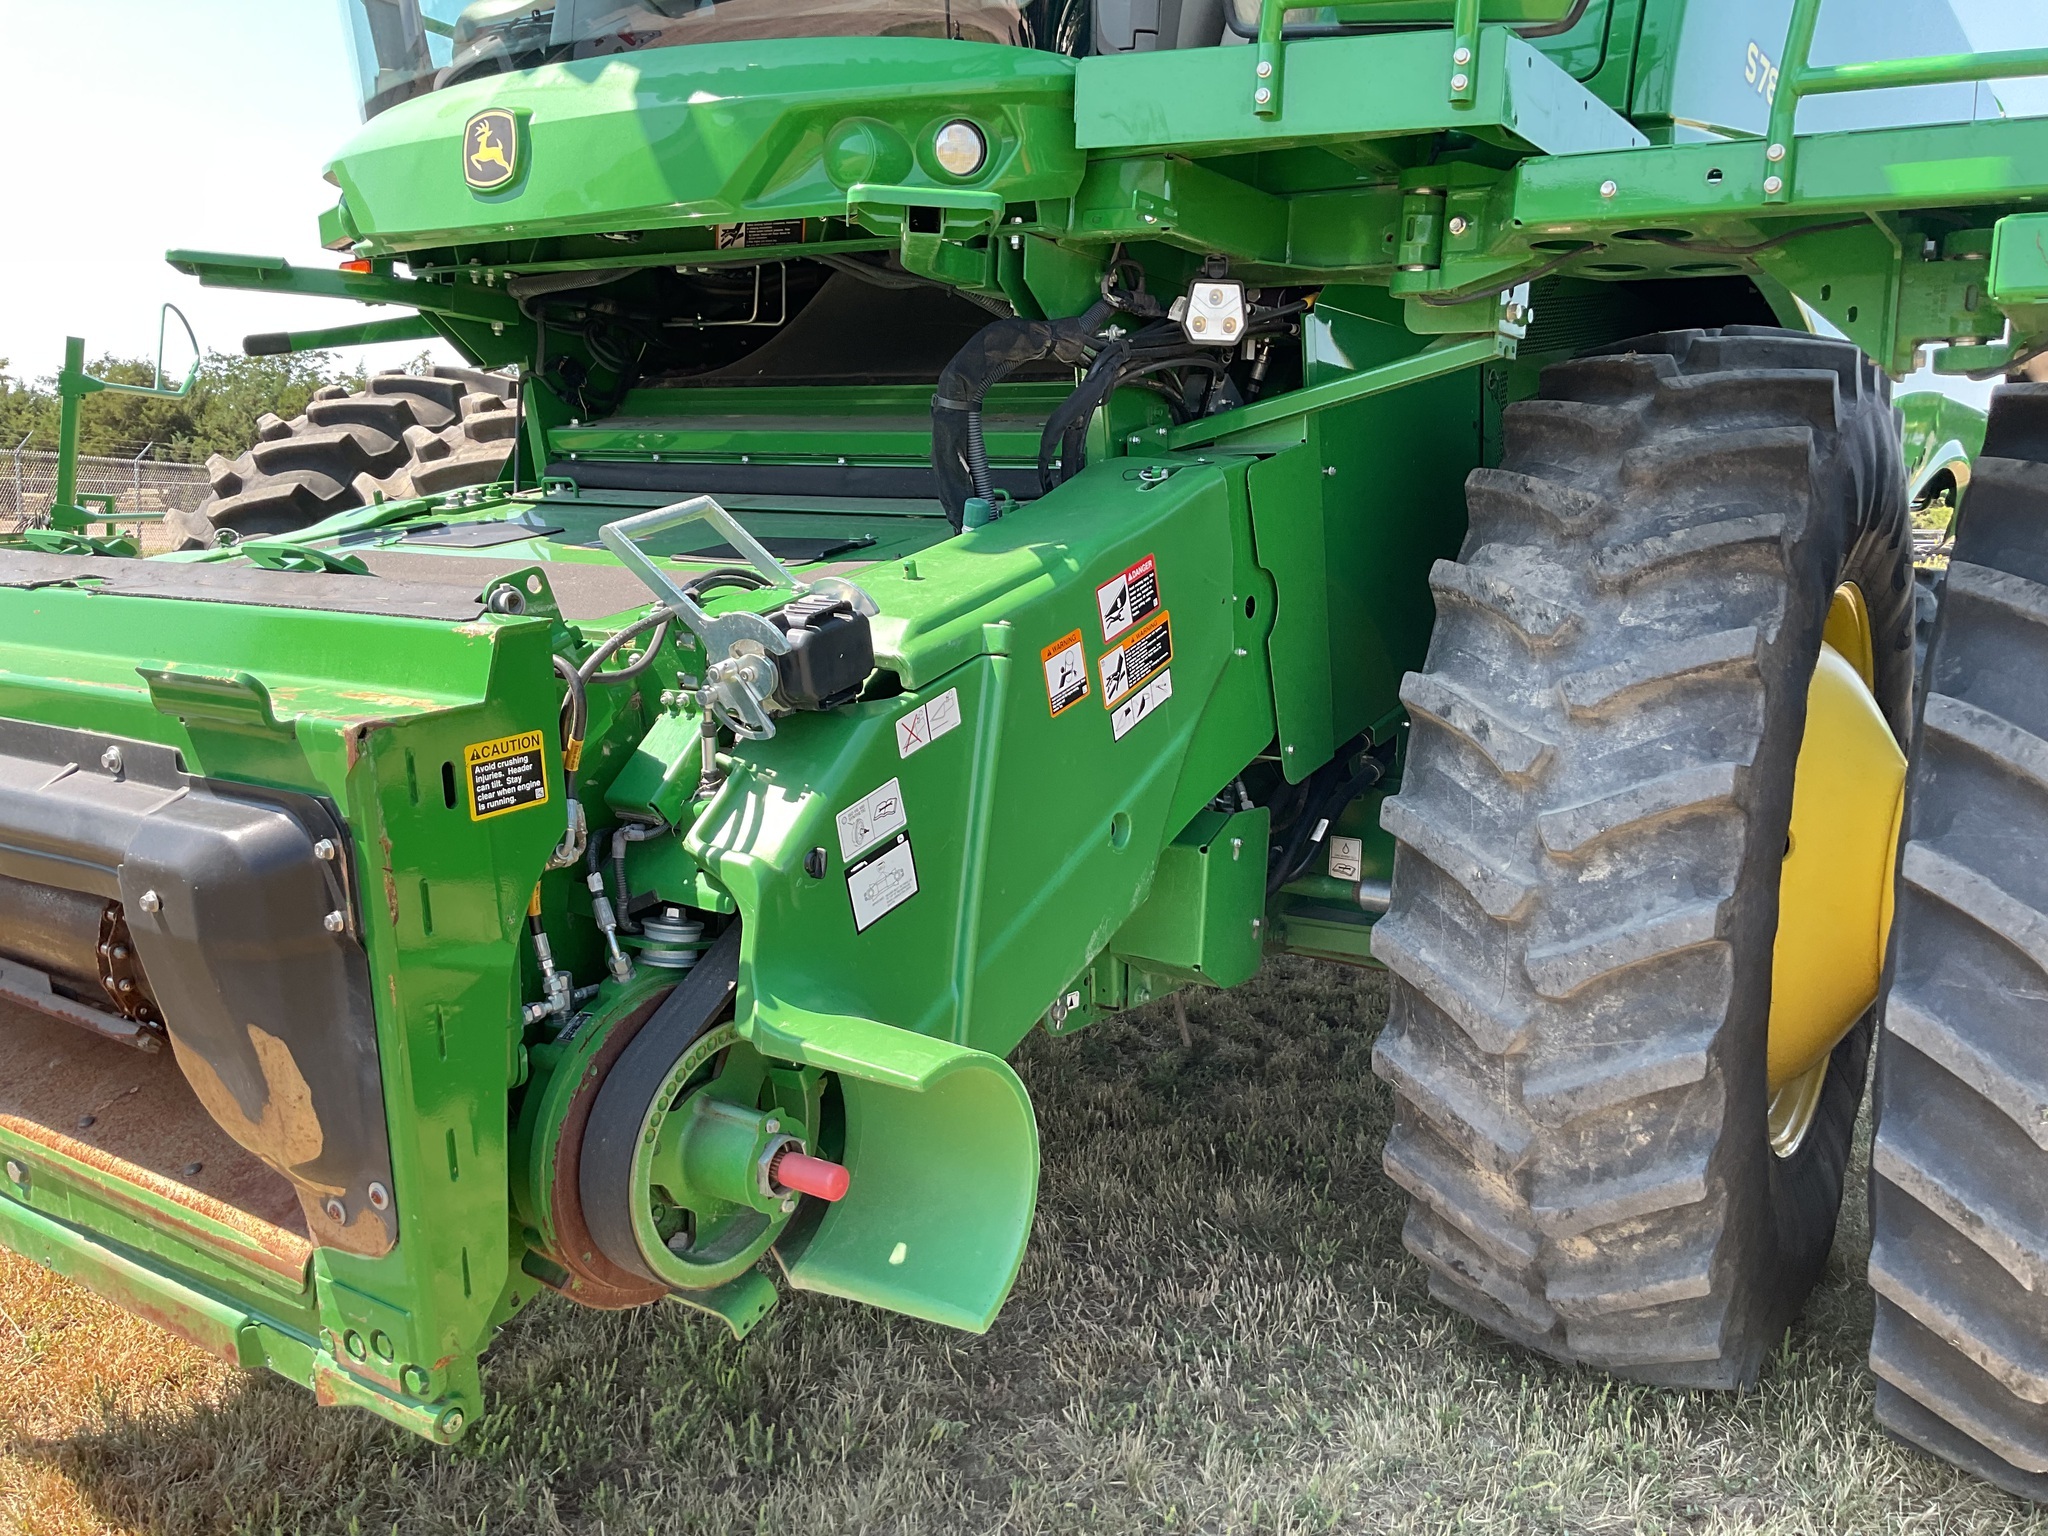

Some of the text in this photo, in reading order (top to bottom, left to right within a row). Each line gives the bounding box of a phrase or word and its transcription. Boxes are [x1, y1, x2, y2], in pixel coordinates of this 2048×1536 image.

[1131, 559, 1153, 579] DANGER
[1136, 620, 1158, 639] WARNING
[1052, 634, 1077, 653] WARNING
[481, 734, 540, 758] CAUTION
[474, 755, 529, 774] Avoid crushing
[475, 763, 533, 783] injuries. Header
[476, 775, 522, 793] can tilt. Stay
[477, 780, 541, 802] clear when engine
[478, 795, 517, 811] is running.
